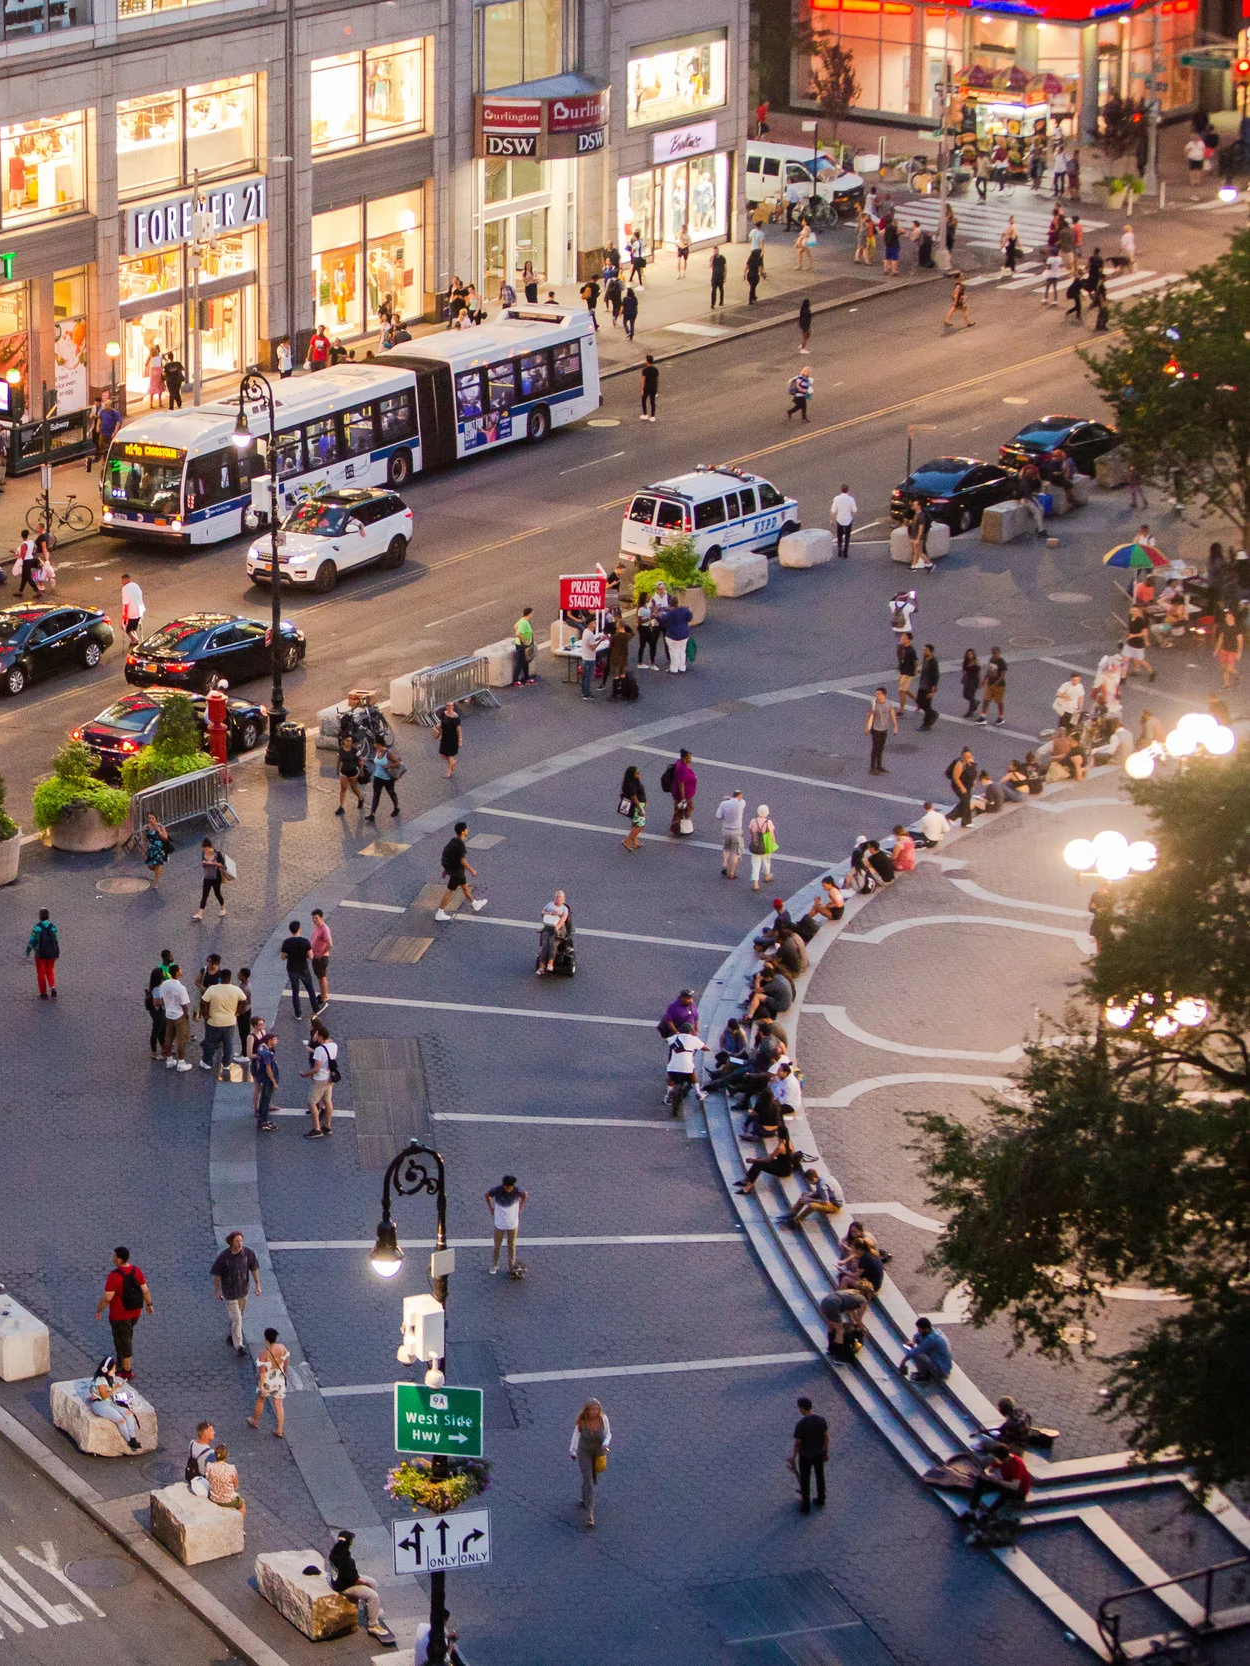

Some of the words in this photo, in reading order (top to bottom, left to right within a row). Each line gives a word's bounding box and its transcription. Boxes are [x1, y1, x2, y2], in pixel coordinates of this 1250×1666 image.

[484, 109, 539, 123] Burlington
[553, 100, 602, 120] Burlin
[488, 137, 535, 155] DSW
[578, 131, 604, 152] DSW
[244, 184, 264, 222] 21
[50, 421, 69, 431] Subway
[753, 516, 778, 534] NYPD
[570, 581, 600, 594] PRAYER
[569, 595, 601, 608] STATION
[433, 1396, 445, 1406] 9A
[405, 1411, 438, 1425] West
[444, 1413, 473, 1428] Side
[412, 1429, 441, 1445] Hwy
[429, 1555, 457, 1567] ONLY
[461, 1552, 488, 1564] ONLY
